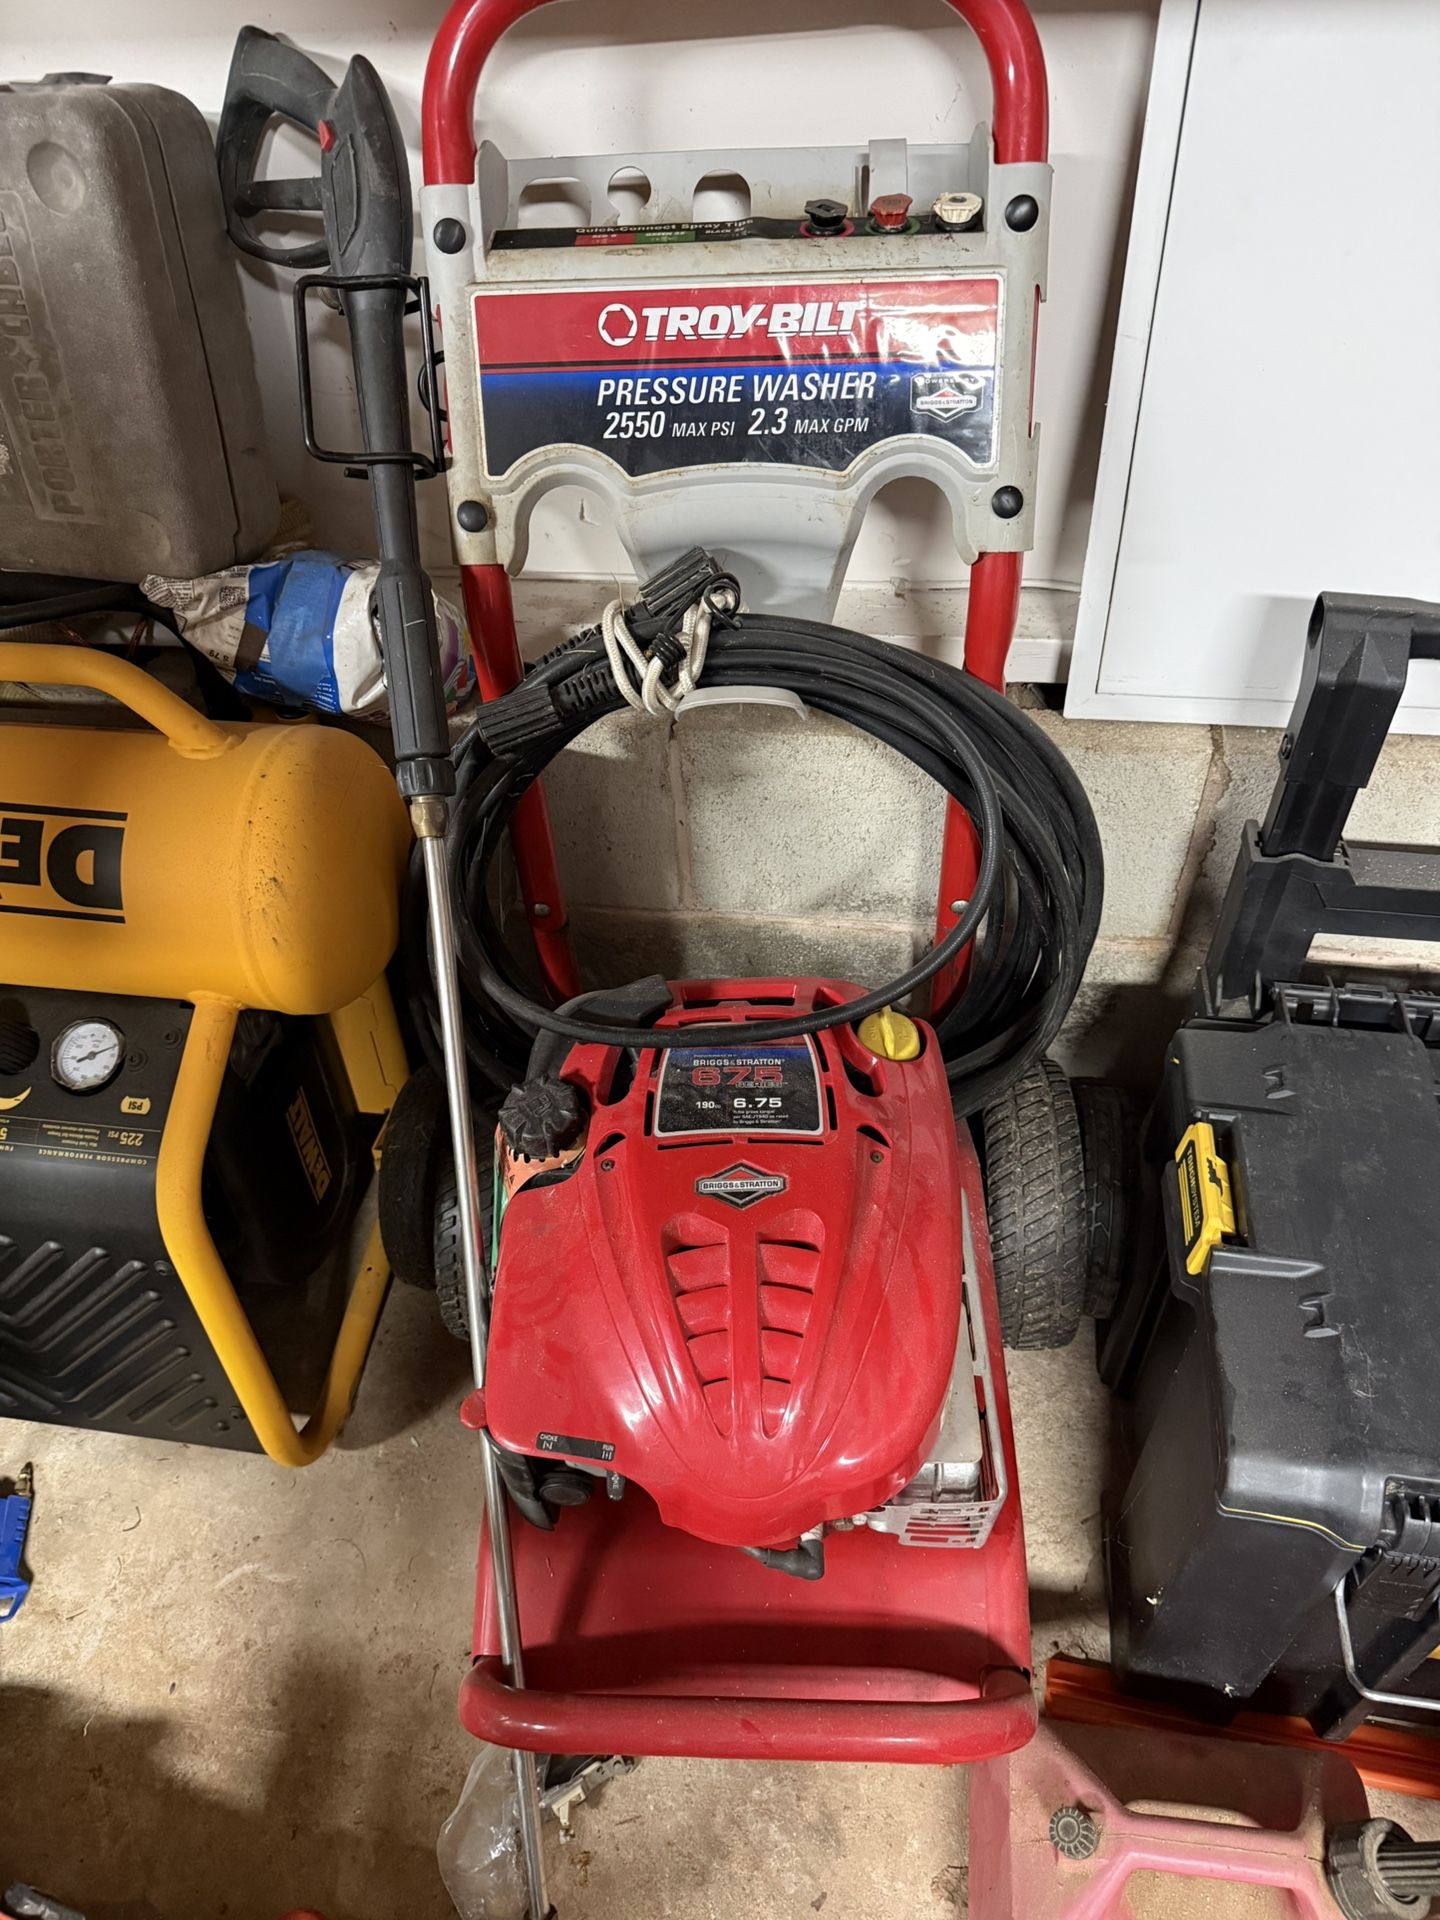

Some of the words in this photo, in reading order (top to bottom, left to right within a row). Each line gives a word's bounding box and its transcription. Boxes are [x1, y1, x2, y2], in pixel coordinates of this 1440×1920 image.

[575, 224, 677, 234] Quick-Connect
[725, 219, 754, 227] Tips
[641, 301, 862, 341] TROY-BILT
[597, 375, 745, 406] PRESSURE
[753, 371, 878, 401] WASHER
[602, 410, 666, 440] 2550
[671, 422, 709, 438] MAX
[710, 421, 736, 437] PSI
[747, 407, 789, 436] 2.3
[793, 418, 829, 434] MAX
[833, 417, 870, 433] GPM
[0, 817, 126, 911] DE
[691, 1066, 783, 1086] 675
[128, 1101, 144, 1111] PSI
[733, 1097, 783, 1108] 6.75
[119, 1131, 145, 1147] 225
[37, 1148, 94, 1160] PERFORMANCE
[95, 1153, 148, 1166] COMPRESSOR
[702, 1180, 780, 1190] BRIGGS&STRATTON
[539, 1433, 559, 1442] CHOKE
[602, 1444, 615, 1452] RUN
